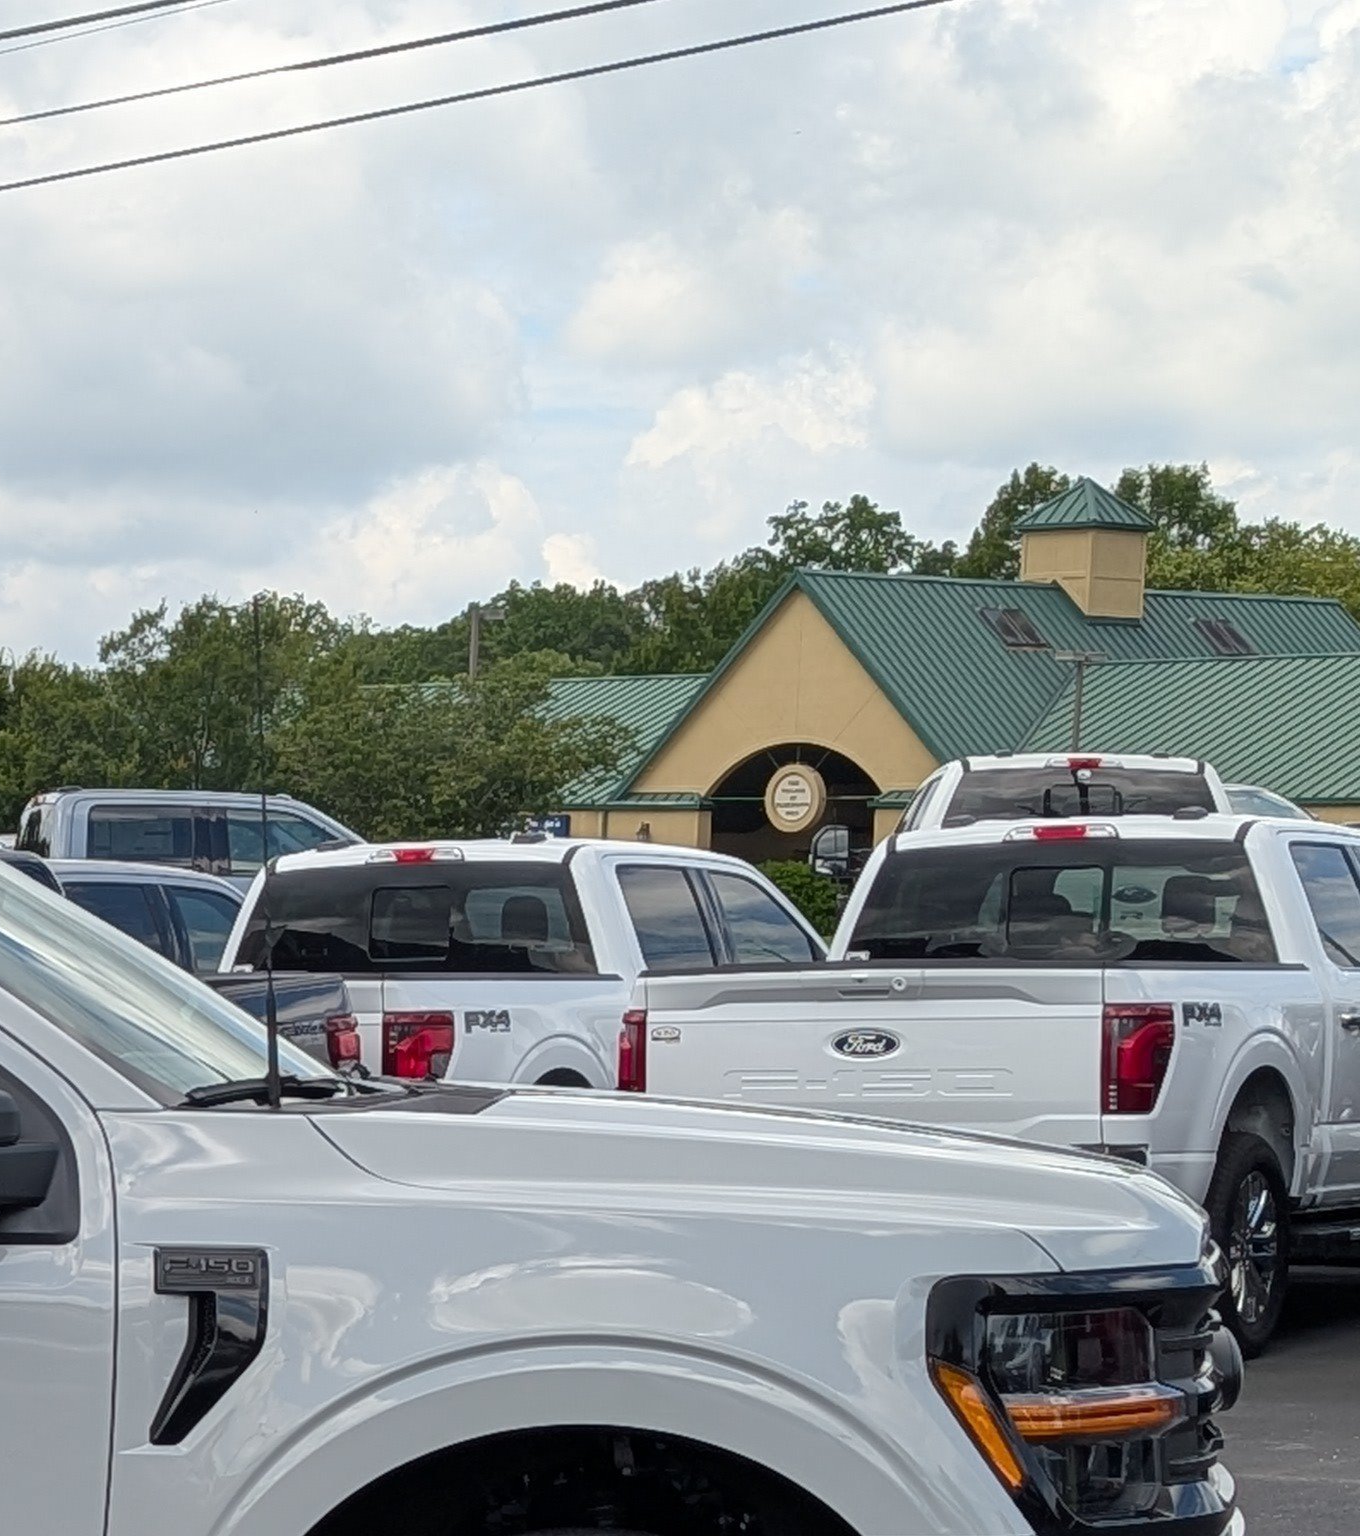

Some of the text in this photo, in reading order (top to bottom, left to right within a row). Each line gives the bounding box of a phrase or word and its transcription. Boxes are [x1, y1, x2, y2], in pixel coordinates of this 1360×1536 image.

[464, 1009, 511, 1034] FX4
[843, 1035, 886, 1053] Ford
[723, 1068, 1013, 1097] F-150
[163, 1257, 255, 1274] F-150
